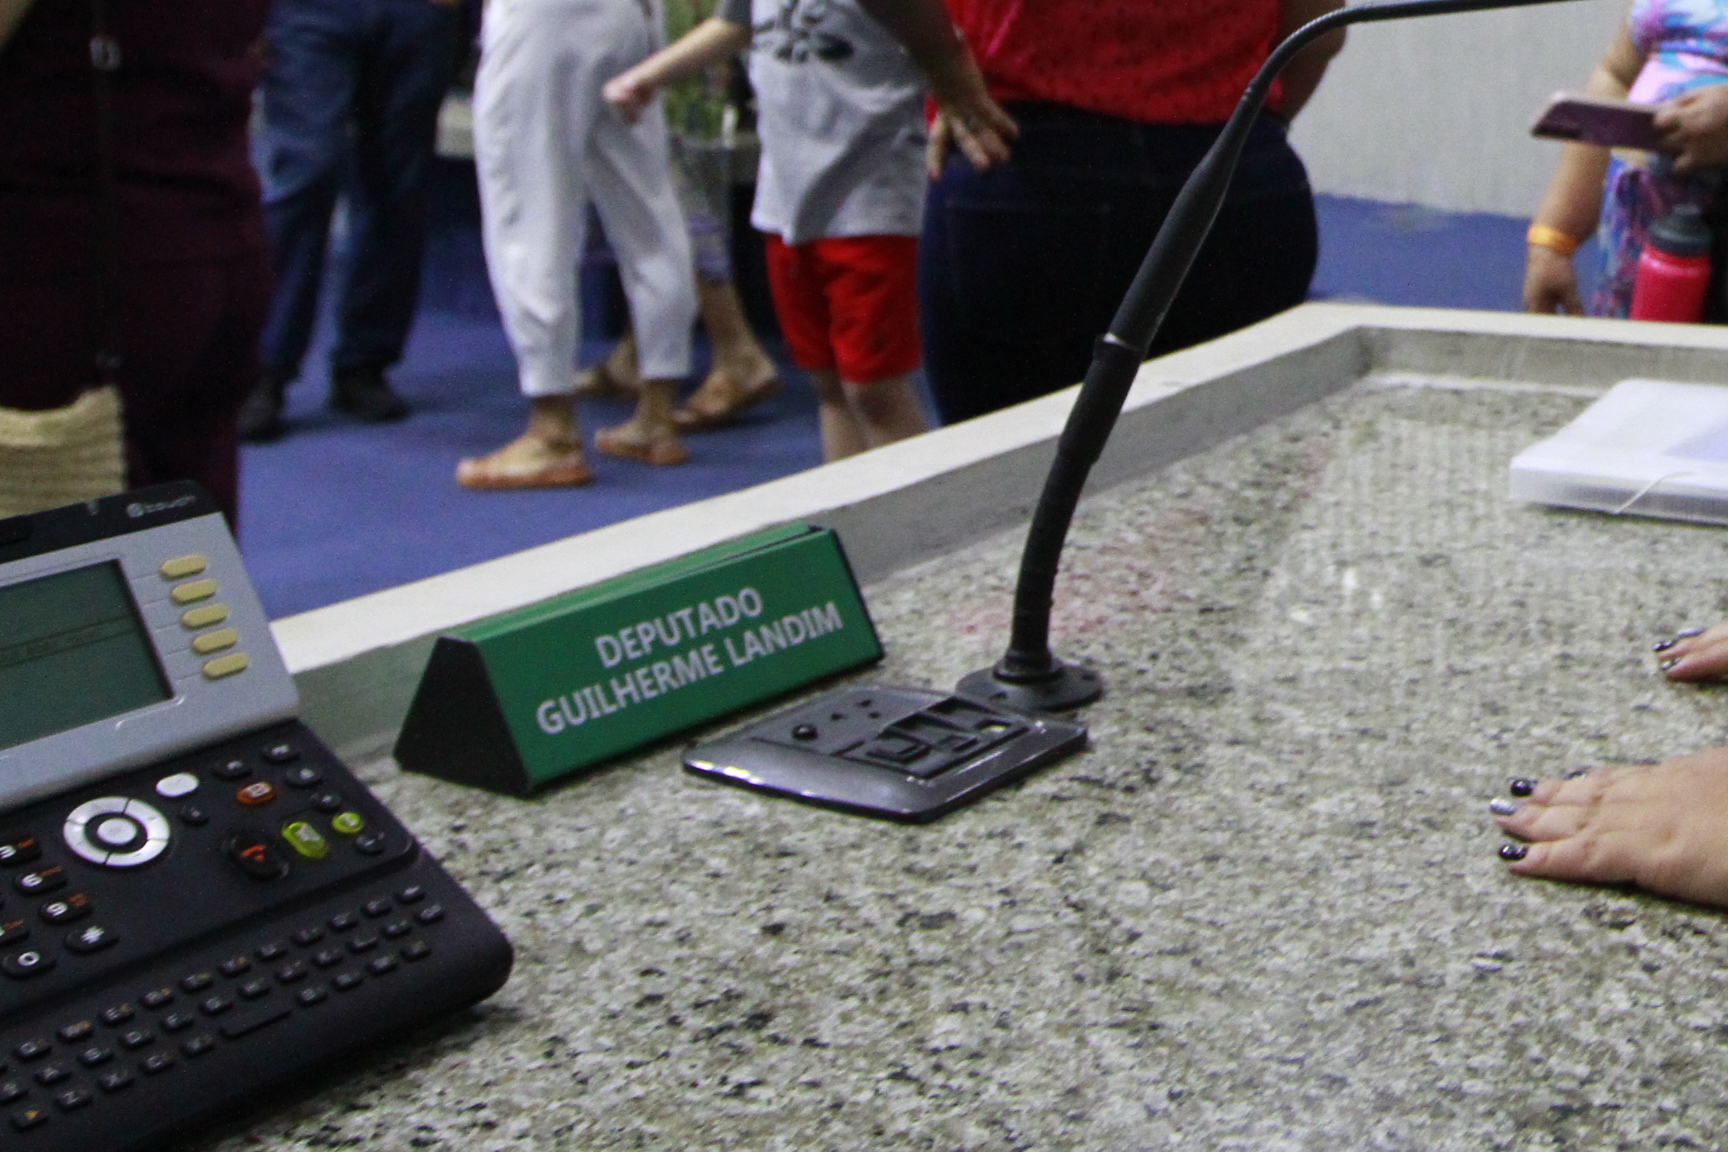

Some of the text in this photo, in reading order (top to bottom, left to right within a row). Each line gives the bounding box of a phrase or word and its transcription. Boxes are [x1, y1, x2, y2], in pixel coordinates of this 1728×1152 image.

[536, 602, 844, 734] GUILHERME LANDIM
[595, 588, 763, 668] DEPUTADO
